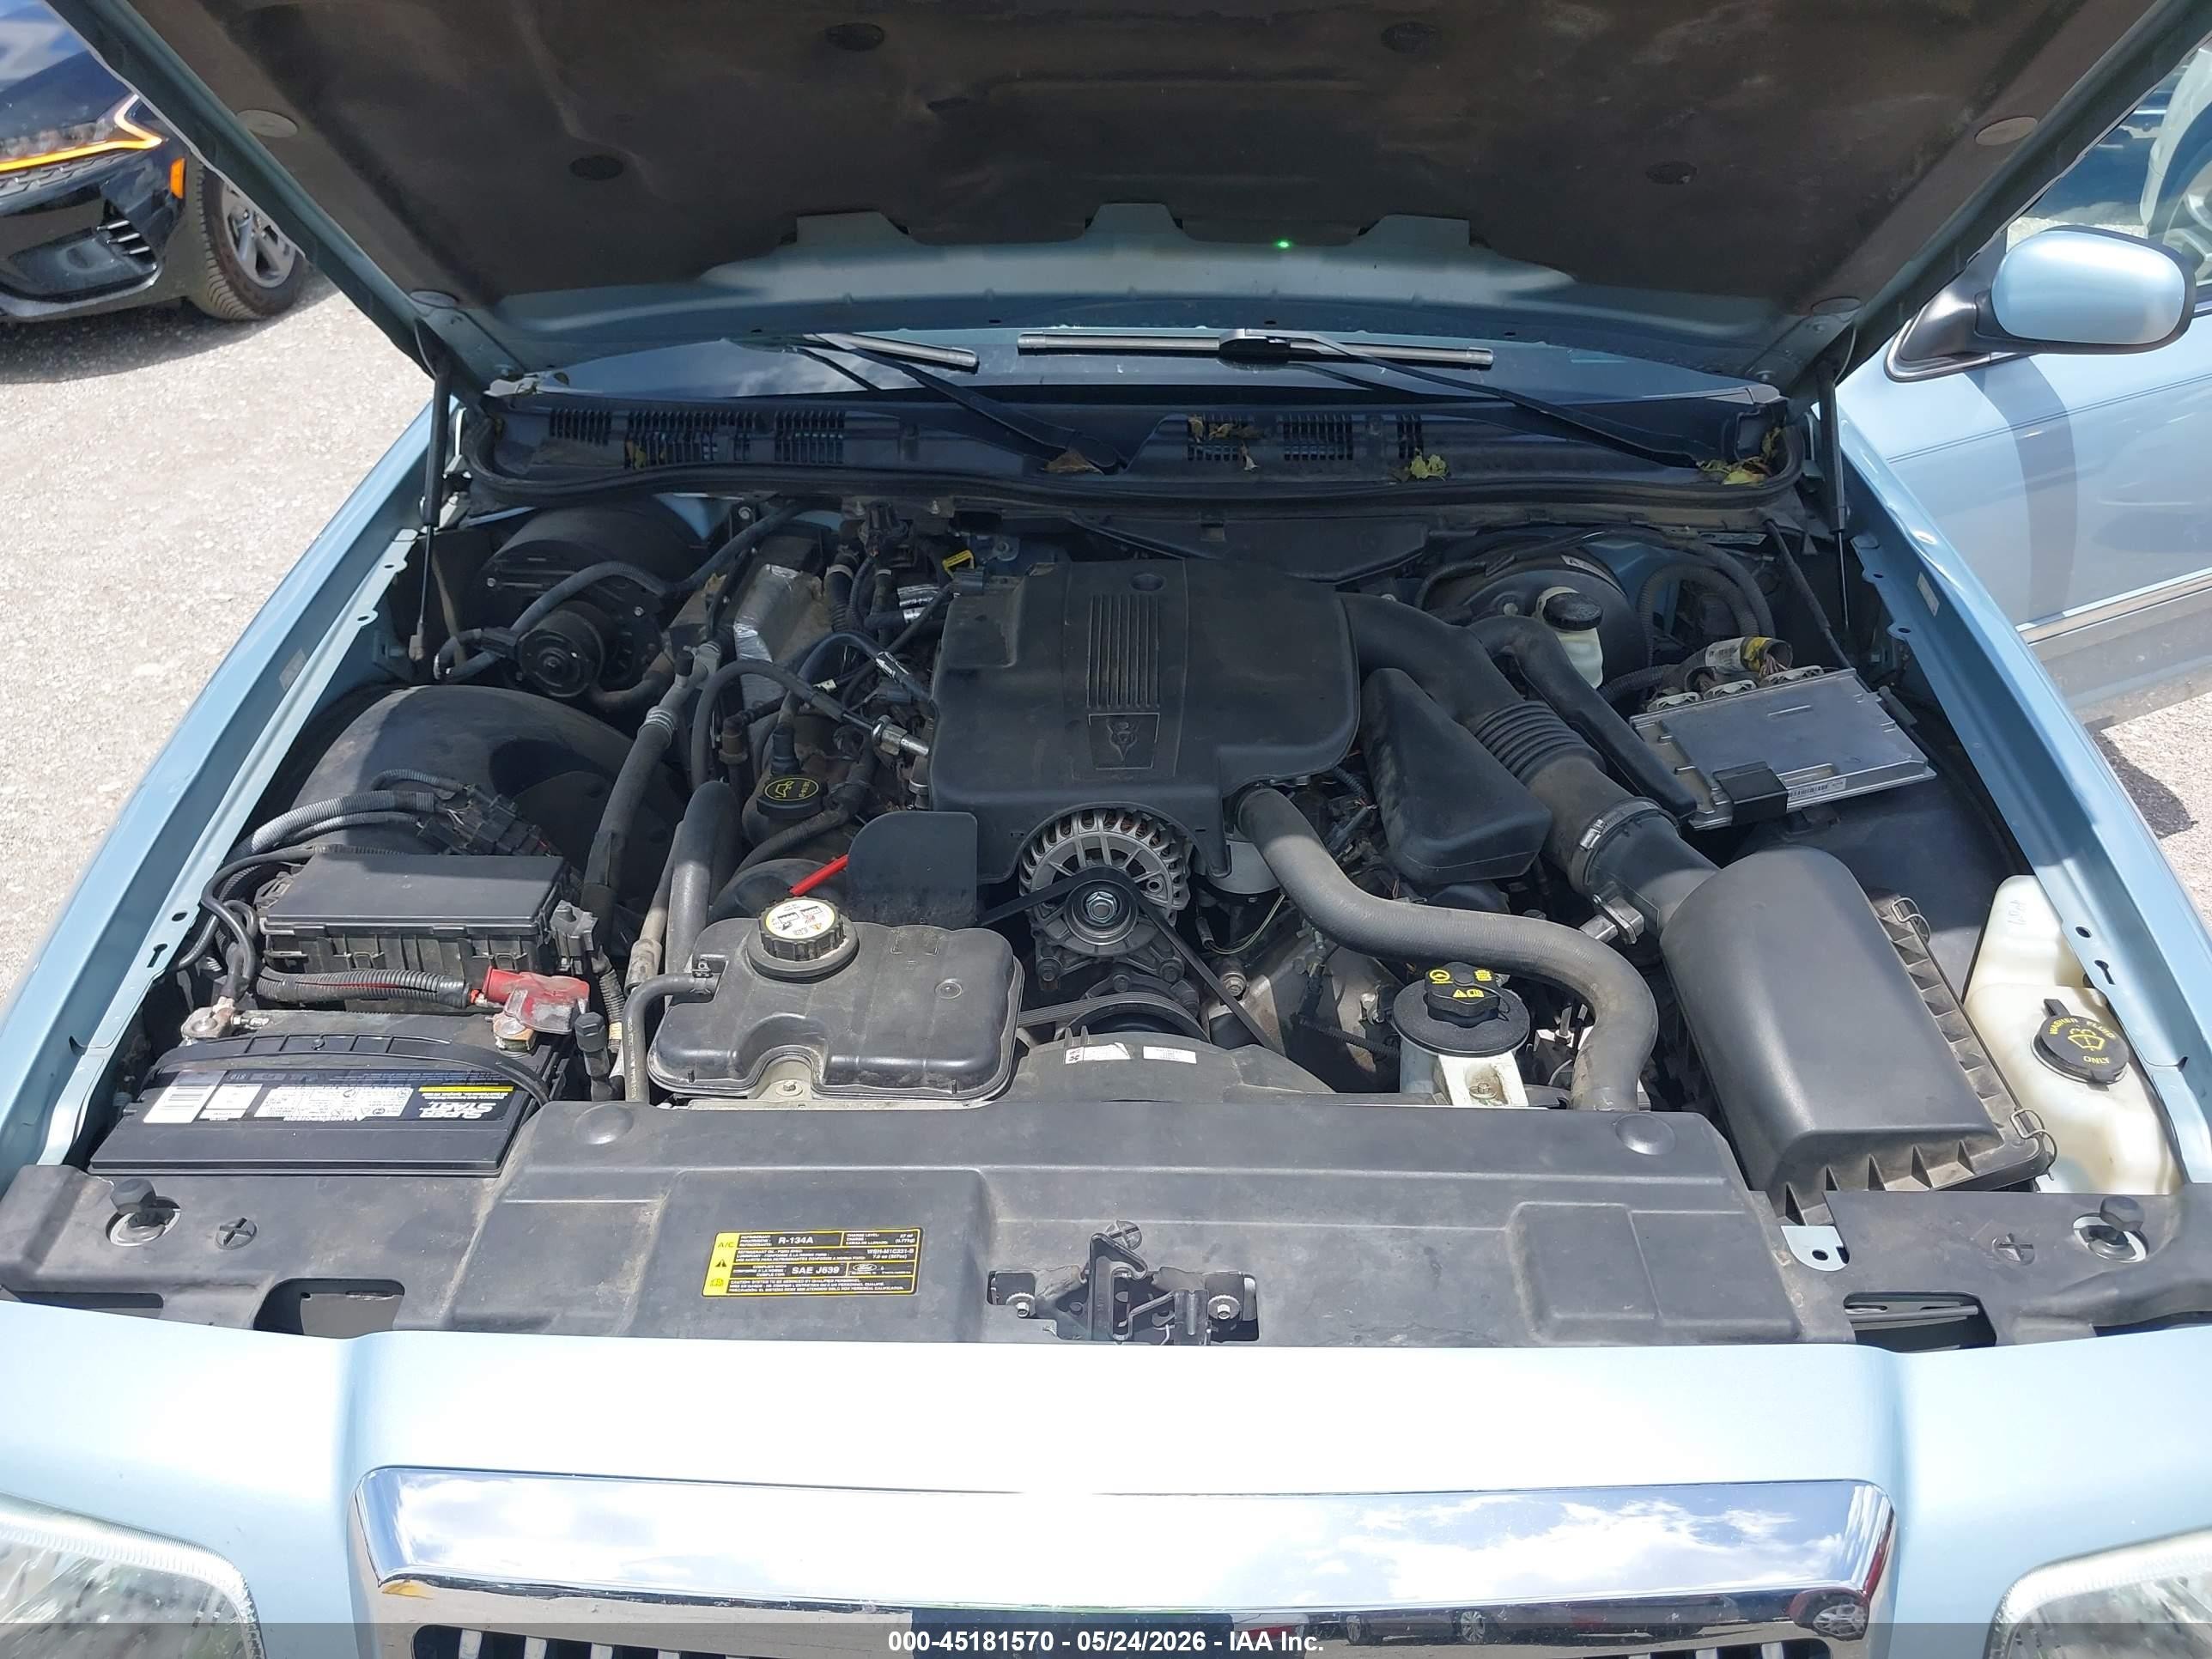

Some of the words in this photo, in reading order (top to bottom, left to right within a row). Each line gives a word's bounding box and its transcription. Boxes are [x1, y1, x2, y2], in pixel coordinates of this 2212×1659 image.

[2049, 1017, 2078, 1035] WASHER
[2087, 1021, 2117, 1039] FLUID
[2083, 1055, 2111, 1064] ONLY
